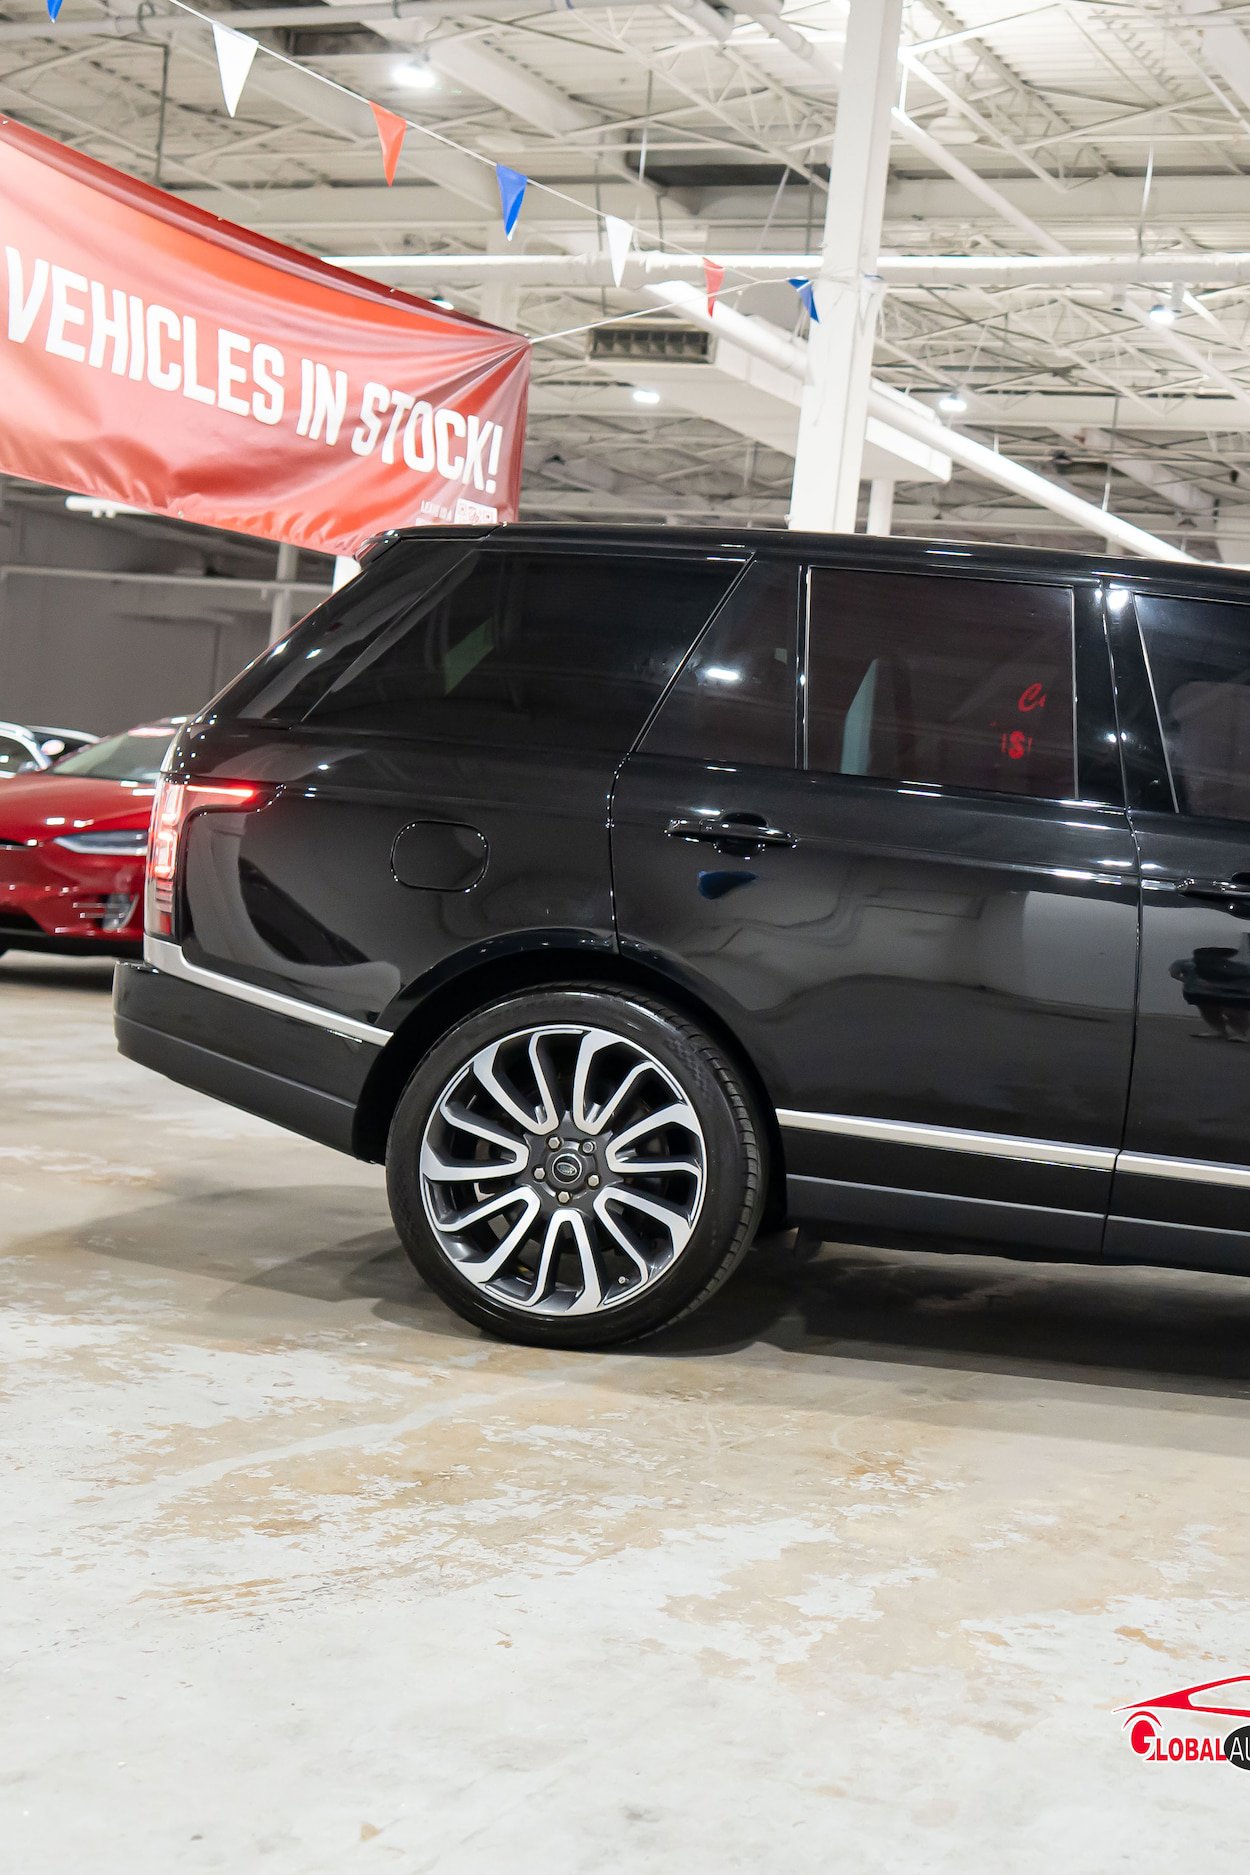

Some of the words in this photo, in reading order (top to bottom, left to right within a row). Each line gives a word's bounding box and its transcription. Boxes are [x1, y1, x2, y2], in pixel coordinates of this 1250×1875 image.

[5, 246, 285, 426] VEHICLES
[296, 358, 349, 447] IN
[351, 383, 504, 495] STOCK!
